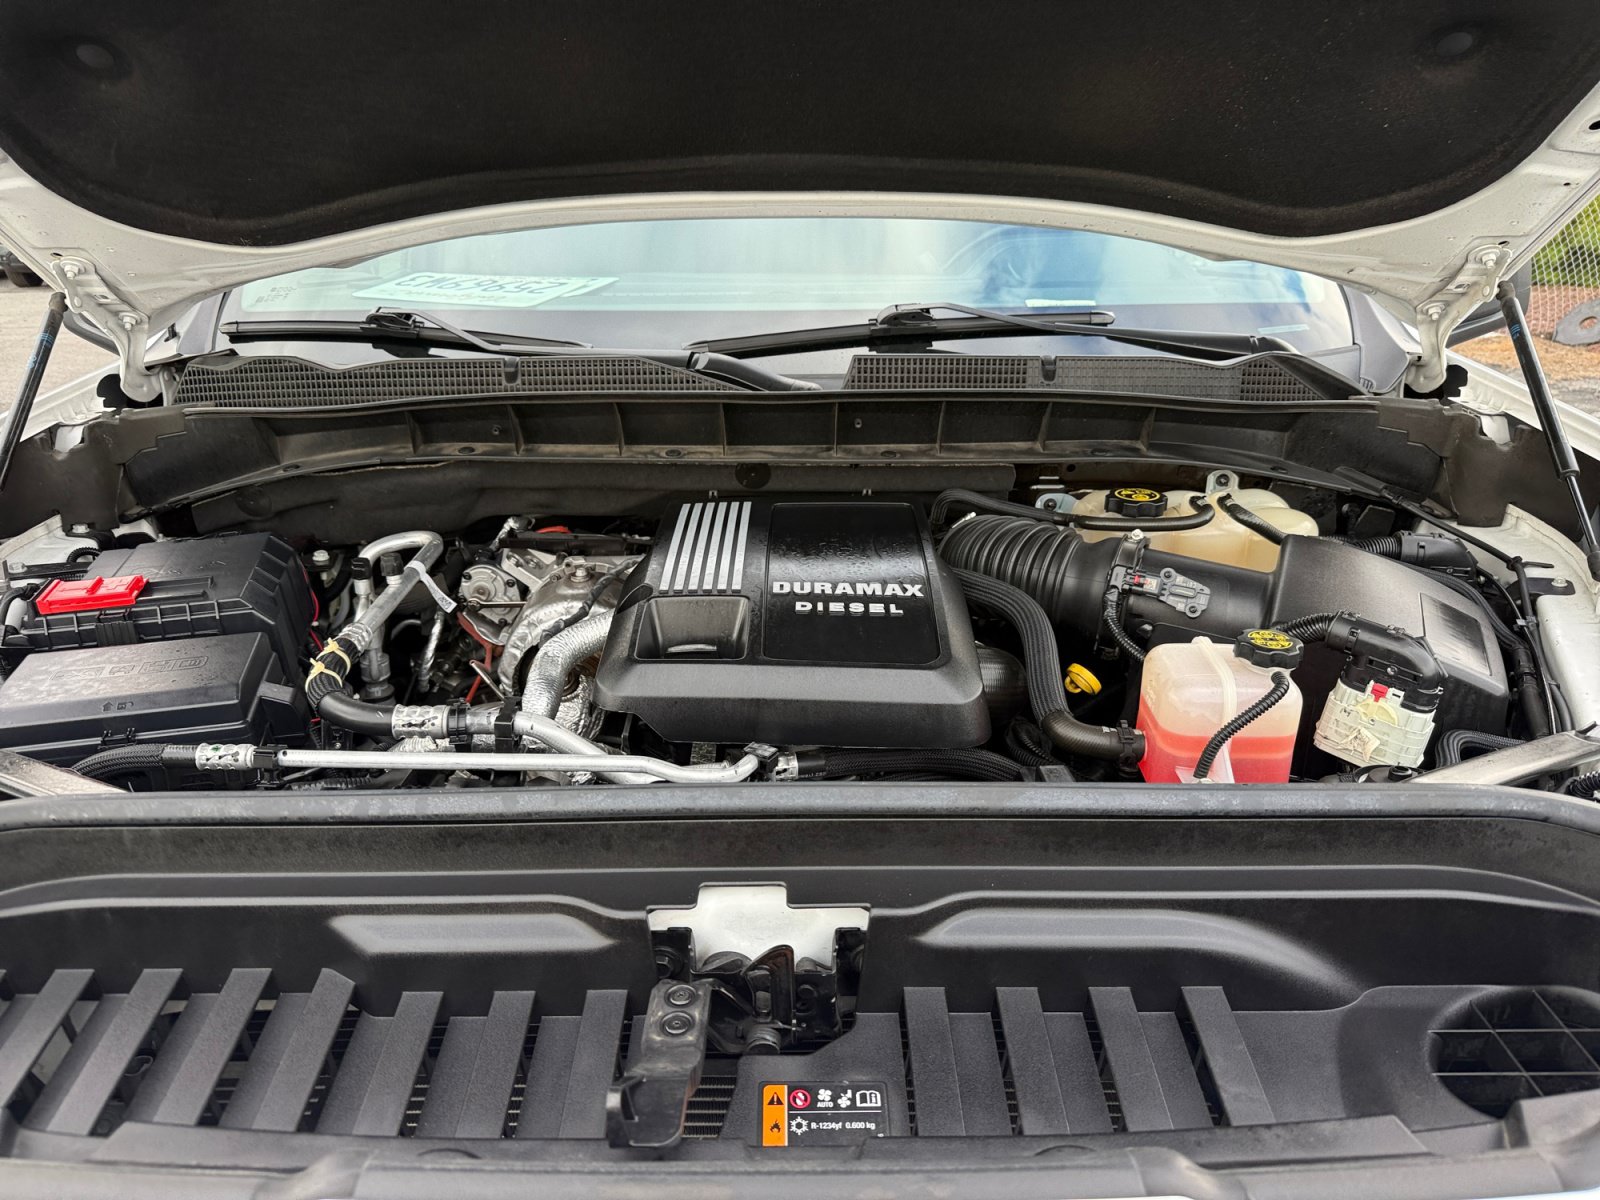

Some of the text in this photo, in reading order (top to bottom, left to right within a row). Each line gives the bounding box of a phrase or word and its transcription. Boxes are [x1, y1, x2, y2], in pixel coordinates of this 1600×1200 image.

[772, 581, 924, 597] DURAMAX
[795, 601, 904, 614] DIESEL
[810, 1121, 842, 1130] R-1234yf
[865, 1121, 876, 1130] kg
